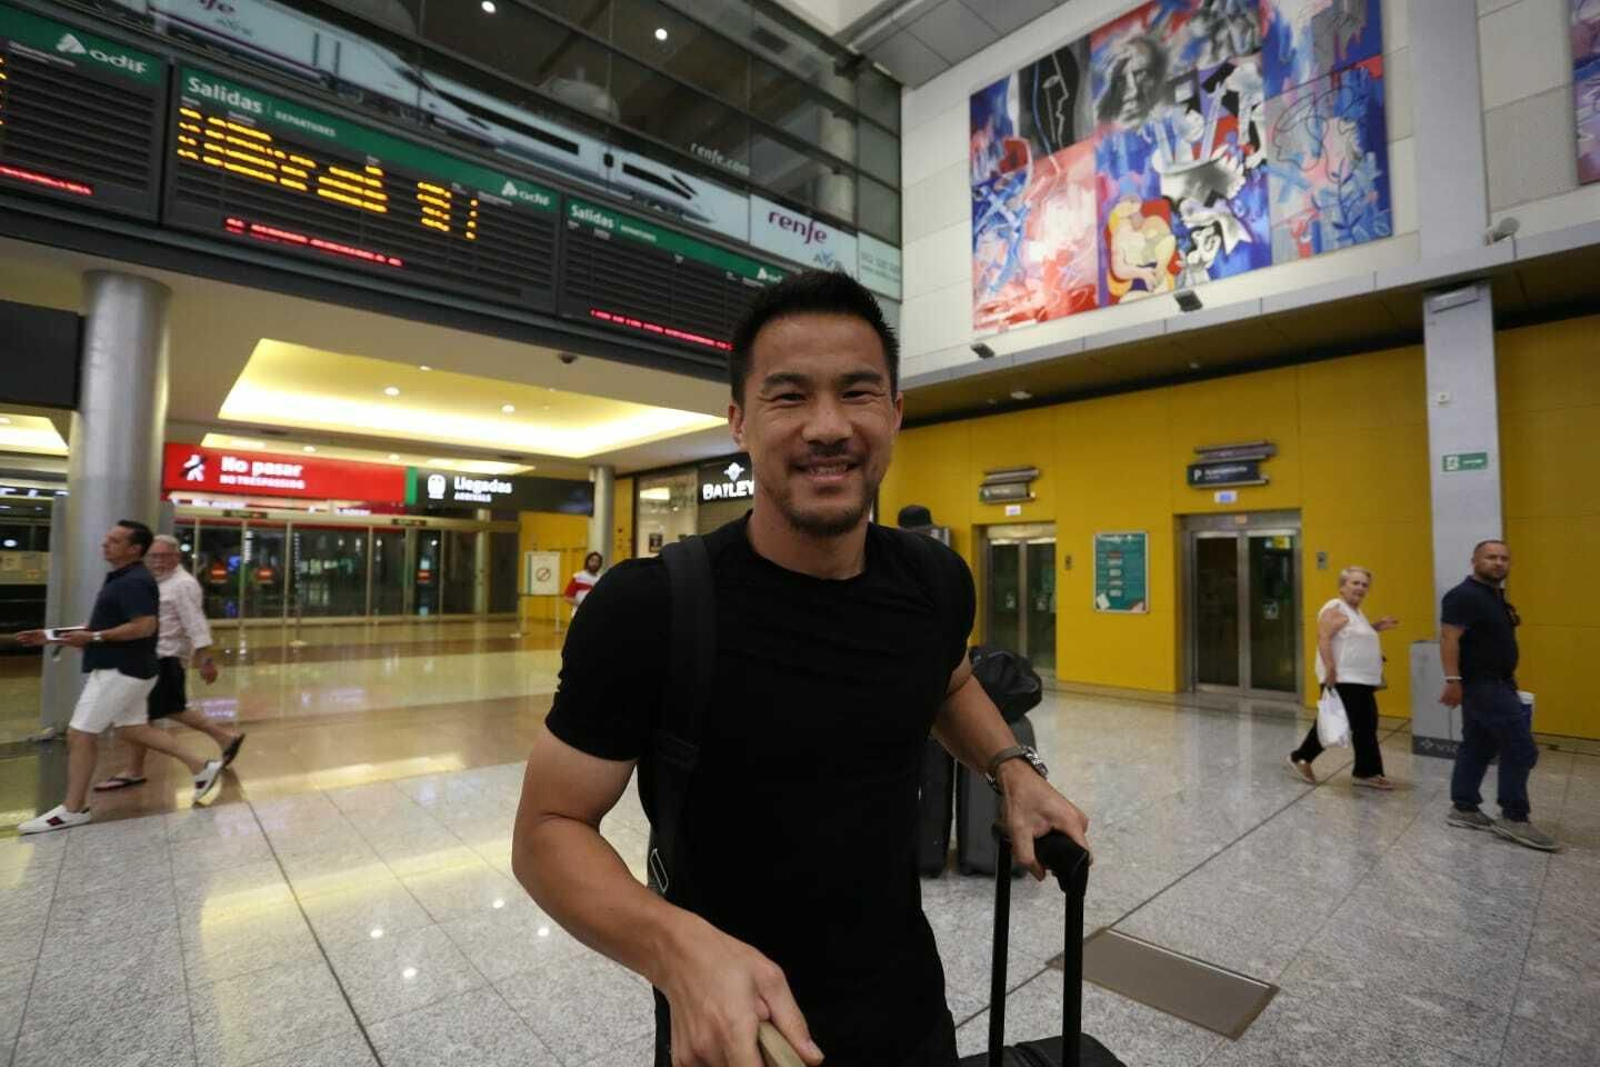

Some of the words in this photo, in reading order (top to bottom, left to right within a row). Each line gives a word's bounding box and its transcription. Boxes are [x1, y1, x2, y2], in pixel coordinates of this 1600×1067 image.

[187, 76, 264, 114] Salidas
[274, 110, 338, 138] DEPARTURES
[690, 142, 750, 177] renfe.com
[570, 203, 616, 230] Salidas
[768, 211, 828, 245] renfe
[221, 456, 249, 473] No
[251, 461, 303, 478] pasar
[453, 475, 513, 495] Llegadas
